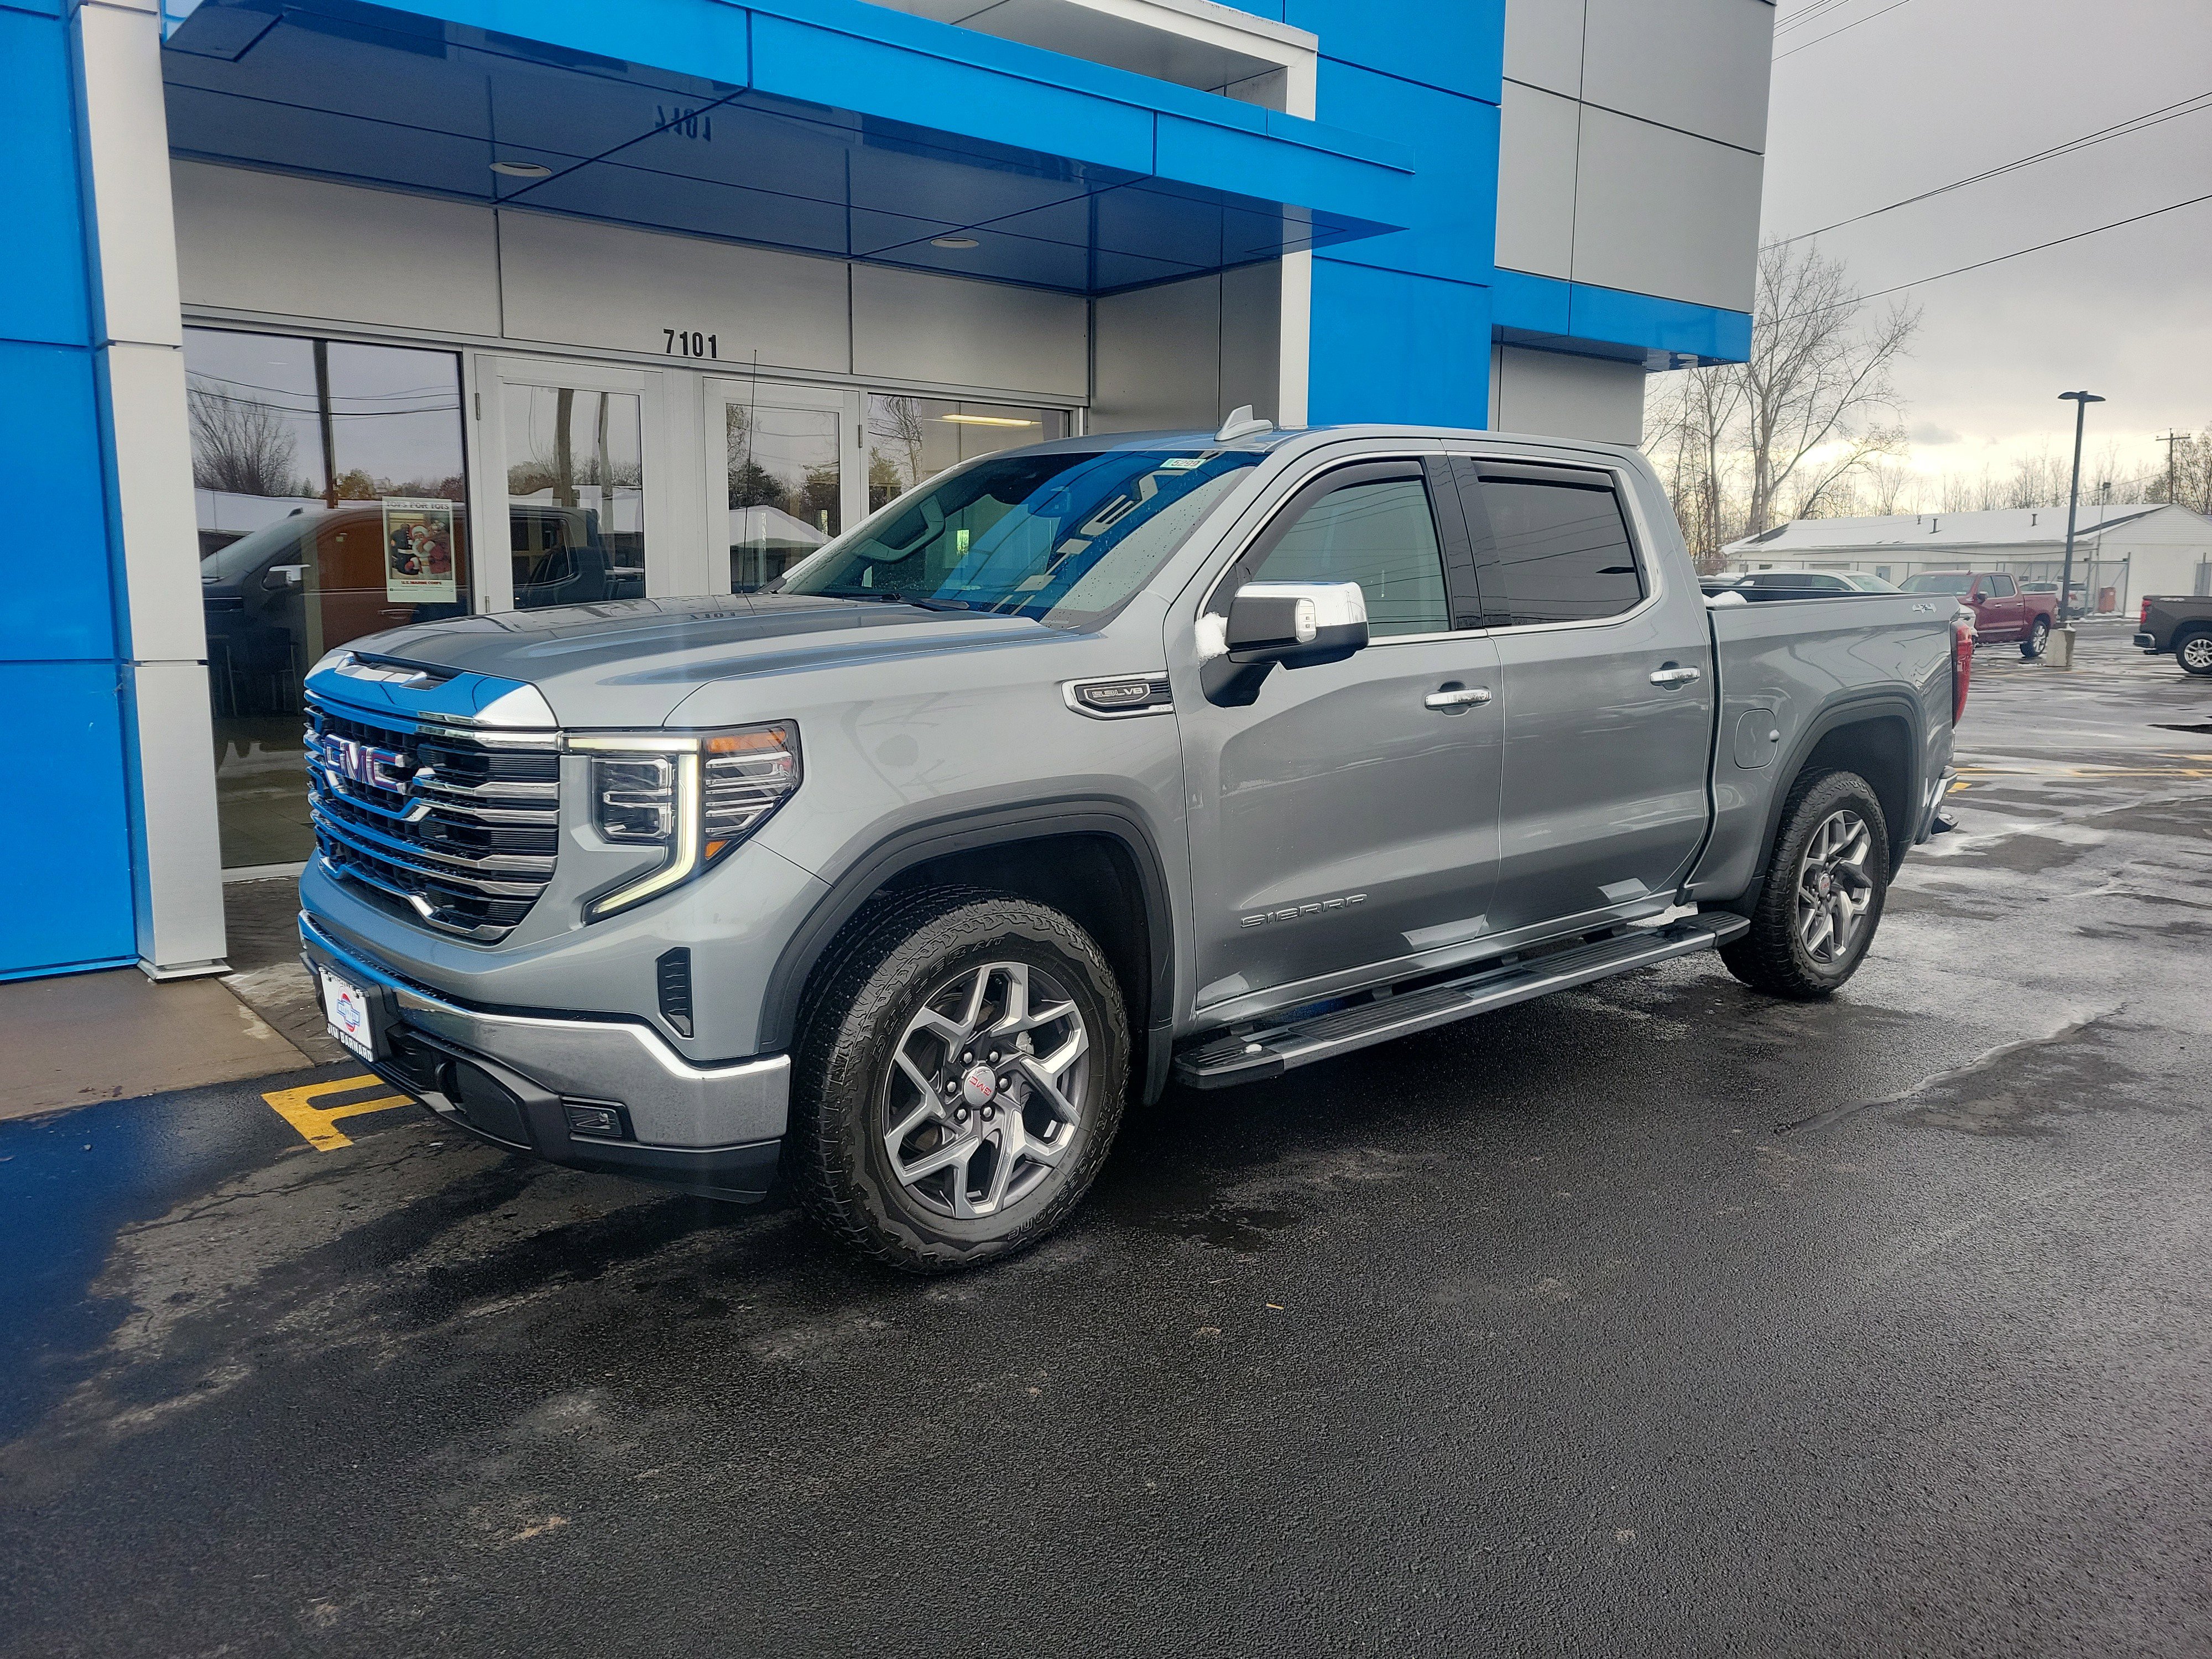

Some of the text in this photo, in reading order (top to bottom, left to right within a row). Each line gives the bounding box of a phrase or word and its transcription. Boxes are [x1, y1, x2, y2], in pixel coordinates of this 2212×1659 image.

[663, 328, 717, 358] 7101
[324, 733, 407, 795] GMC
[1240, 893, 1368, 928] SIERRA
[327, 1022, 374, 1063] JIM BARNARD
[968, 1075, 992, 1096] GMC
[1007, 1091, 1113, 1240] BRIDGESTONE
